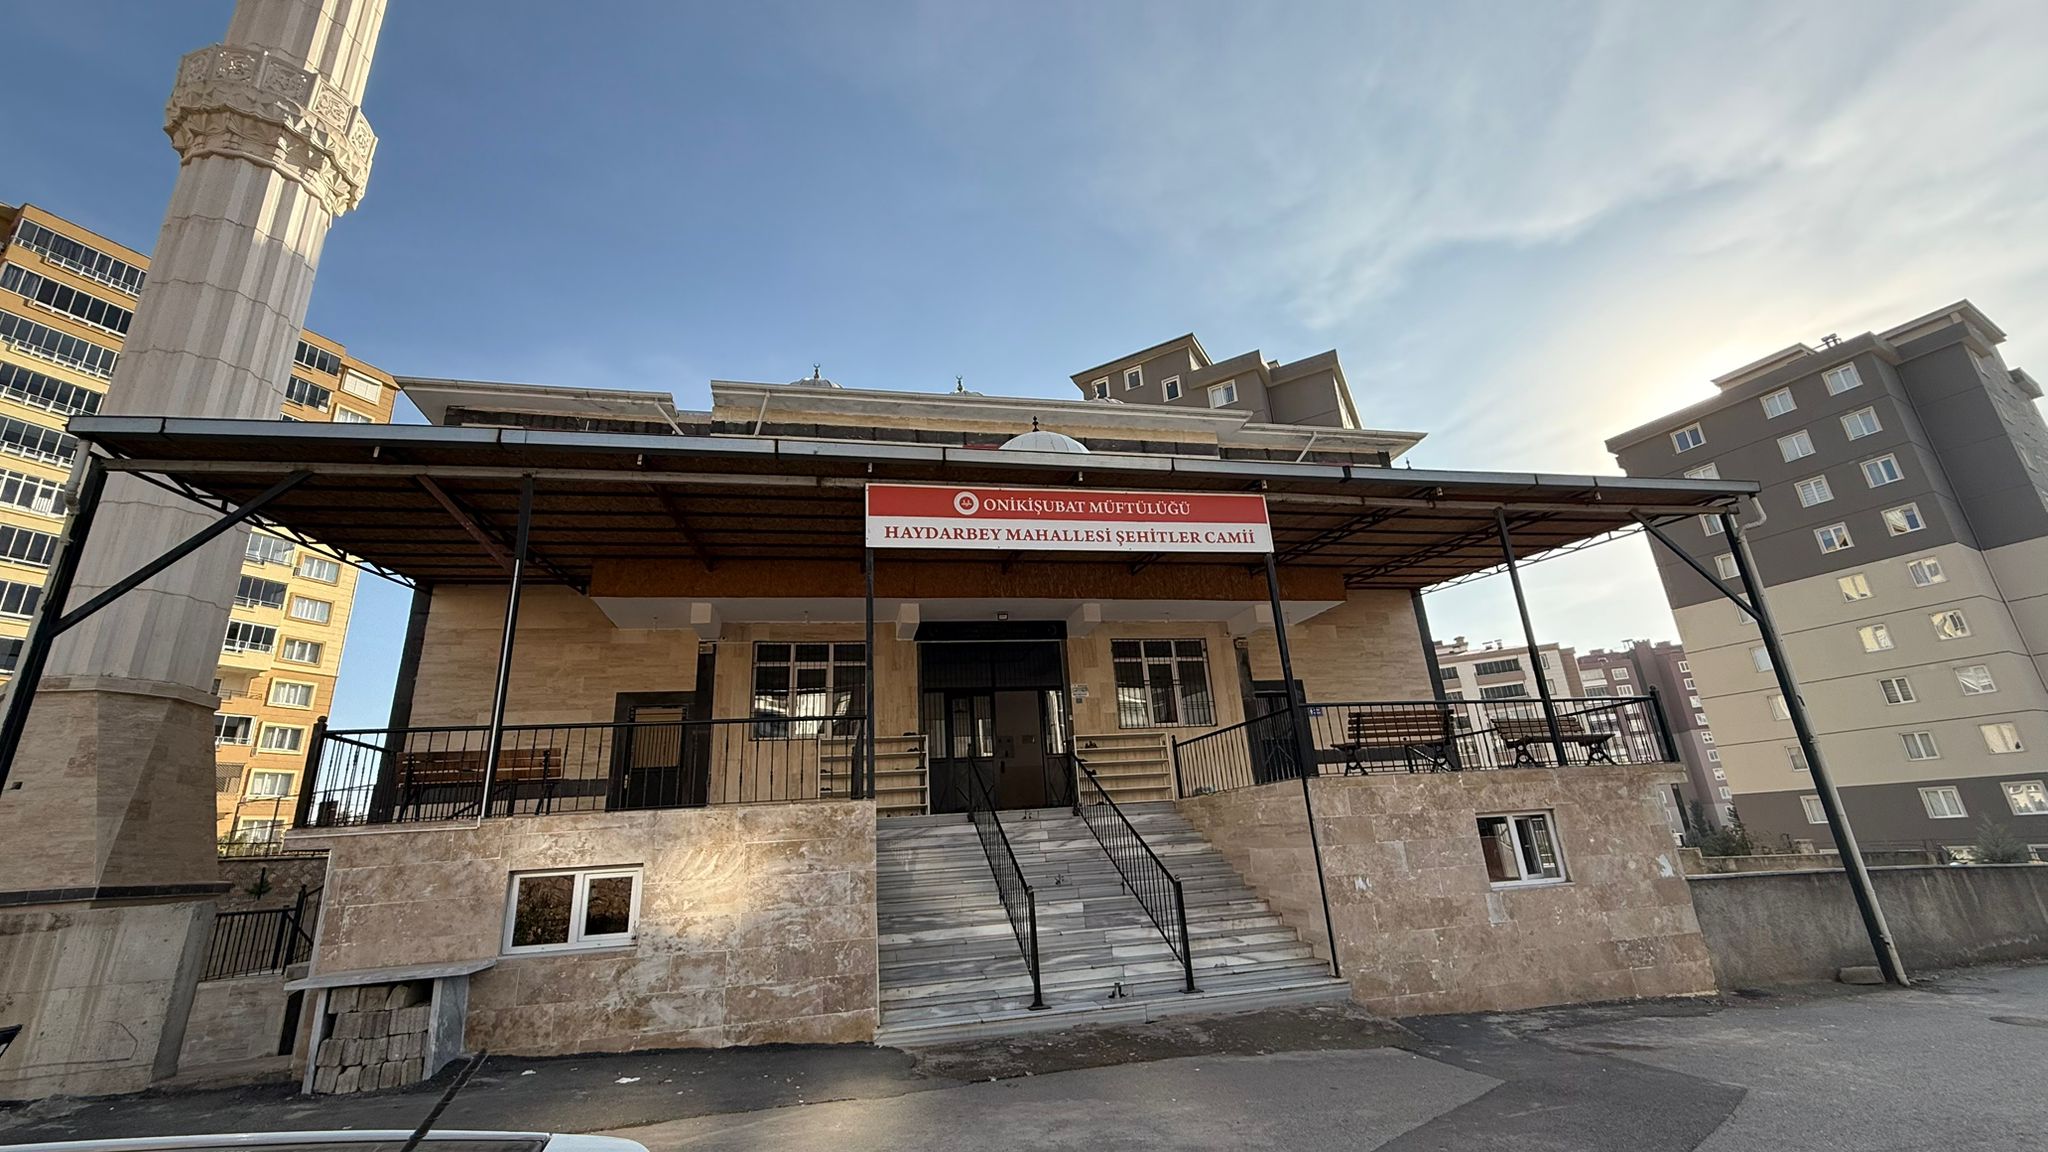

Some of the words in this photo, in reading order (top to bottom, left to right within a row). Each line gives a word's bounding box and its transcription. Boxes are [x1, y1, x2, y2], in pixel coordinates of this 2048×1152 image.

[983, 497, 1086, 515] ONİKİŞUBAT
[1089, 499, 1190, 515] MÜFTÜLÜĞÜ
[884, 525, 1001, 541] HAYDARBEY
[1005, 528, 1112, 543] MAHALLESİ
[1115, 528, 1202, 547] ŞEHİTLER
[1204, 529, 1256, 544] CAMİİ
